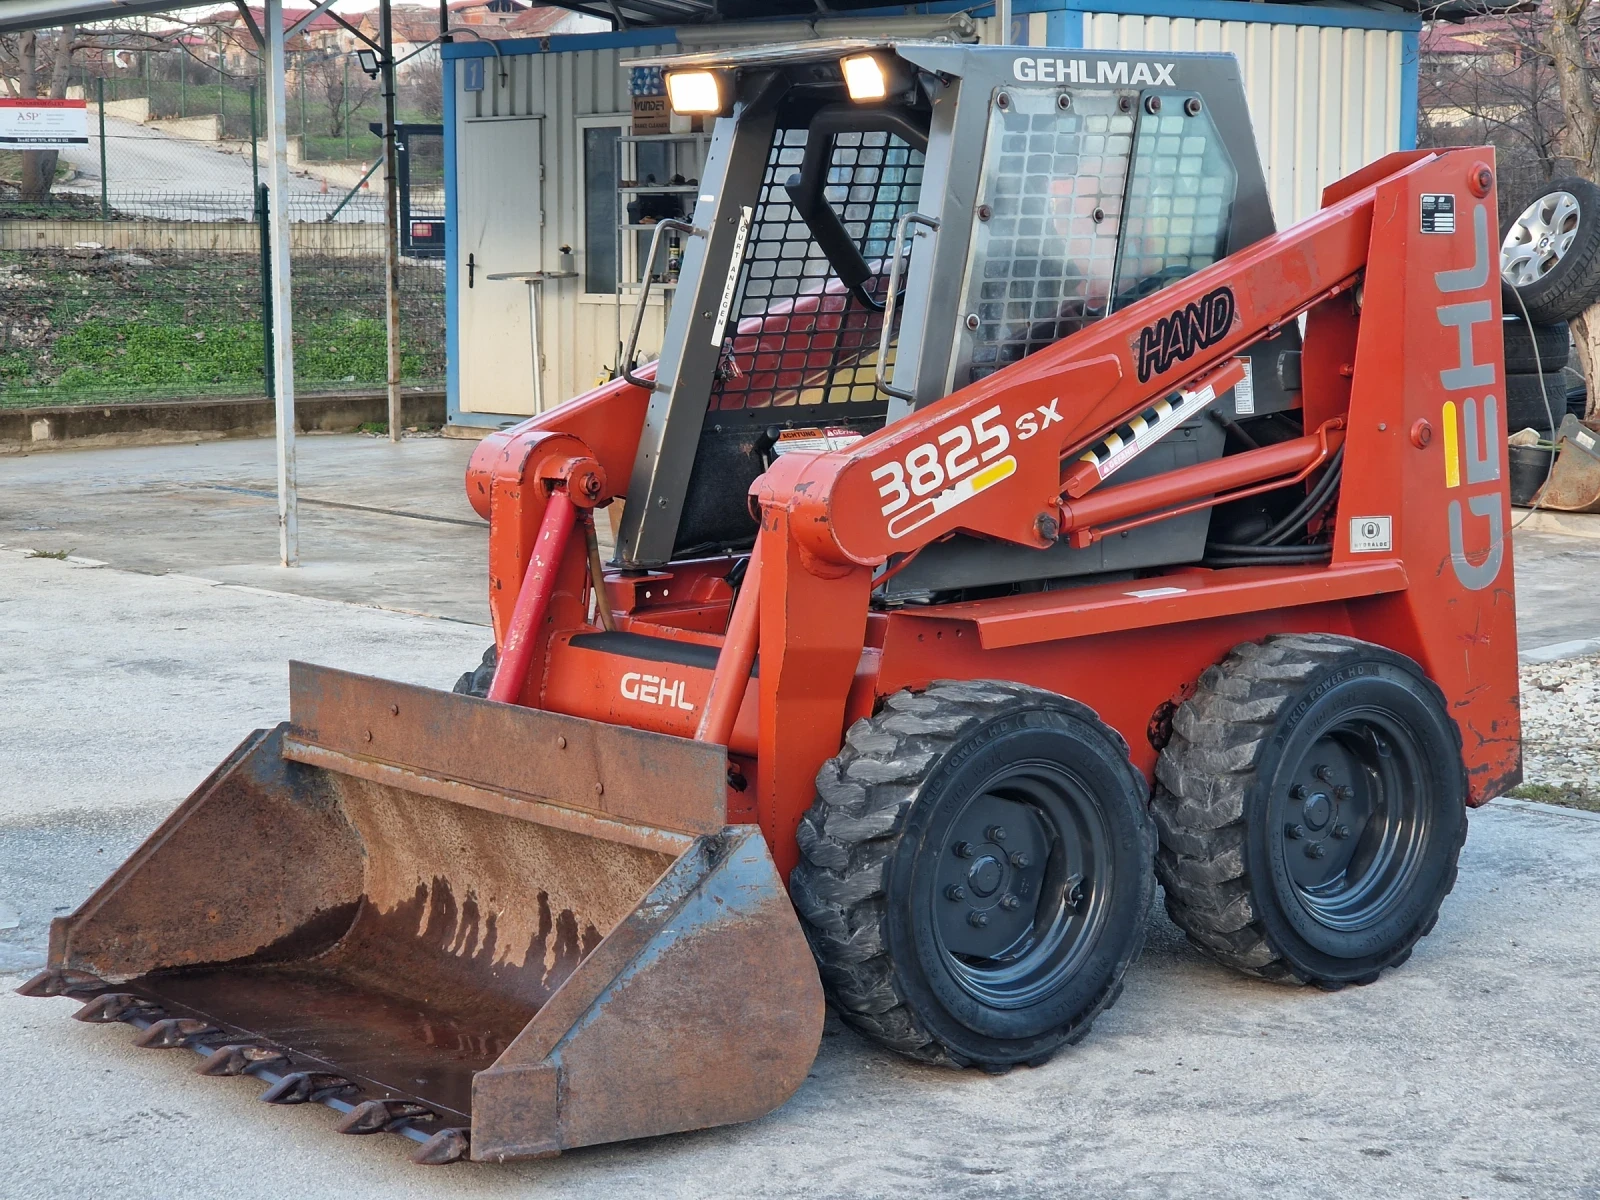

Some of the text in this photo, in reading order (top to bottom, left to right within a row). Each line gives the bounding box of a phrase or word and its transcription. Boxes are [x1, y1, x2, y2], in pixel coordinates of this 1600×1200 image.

[1010, 21, 1021, 45] 2
[470, 63, 477, 87] 1
[1013, 57, 1176, 86] GEHLMAX
[17, 112, 39, 121] ASP
[634, 100, 665, 111] WUNDER
[717, 225, 746, 326] GURT ANLEGEN
[1138, 286, 1235, 383] HAND
[1434, 203, 1504, 591] GEHL
[782, 431, 816, 439] ACHTUNG
[871, 404, 1010, 517] 3825
[1107, 444, 1136, 469] GEFAHR
[620, 672, 694, 711] GEHL
[1286, 665, 1364, 729] SKID POWER HD
[919, 722, 1008, 813] SKID POWER HD
